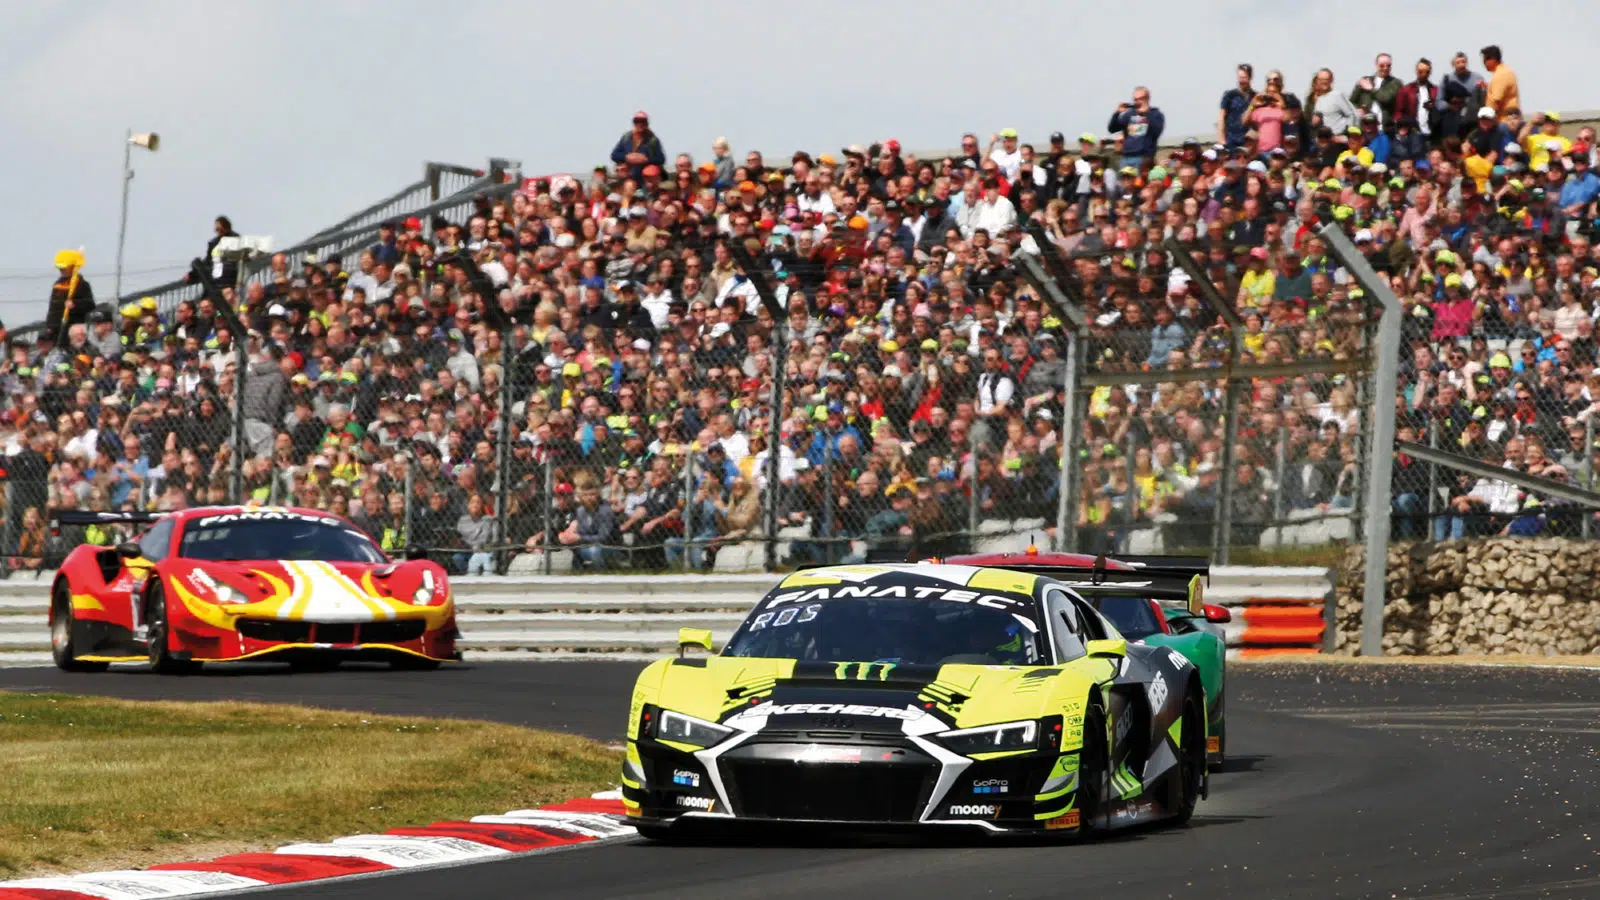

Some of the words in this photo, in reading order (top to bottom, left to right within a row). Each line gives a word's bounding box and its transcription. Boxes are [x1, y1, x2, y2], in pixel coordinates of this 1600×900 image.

[199, 512, 341, 527] FANATEC
[766, 586, 1017, 609] FANATEC
[749, 604, 823, 631] ROS
[738, 702, 926, 720] SKECHERS
[674, 769, 699, 780] GoPro
[677, 796, 715, 813] mooney
[950, 805, 1001, 820] mooney
